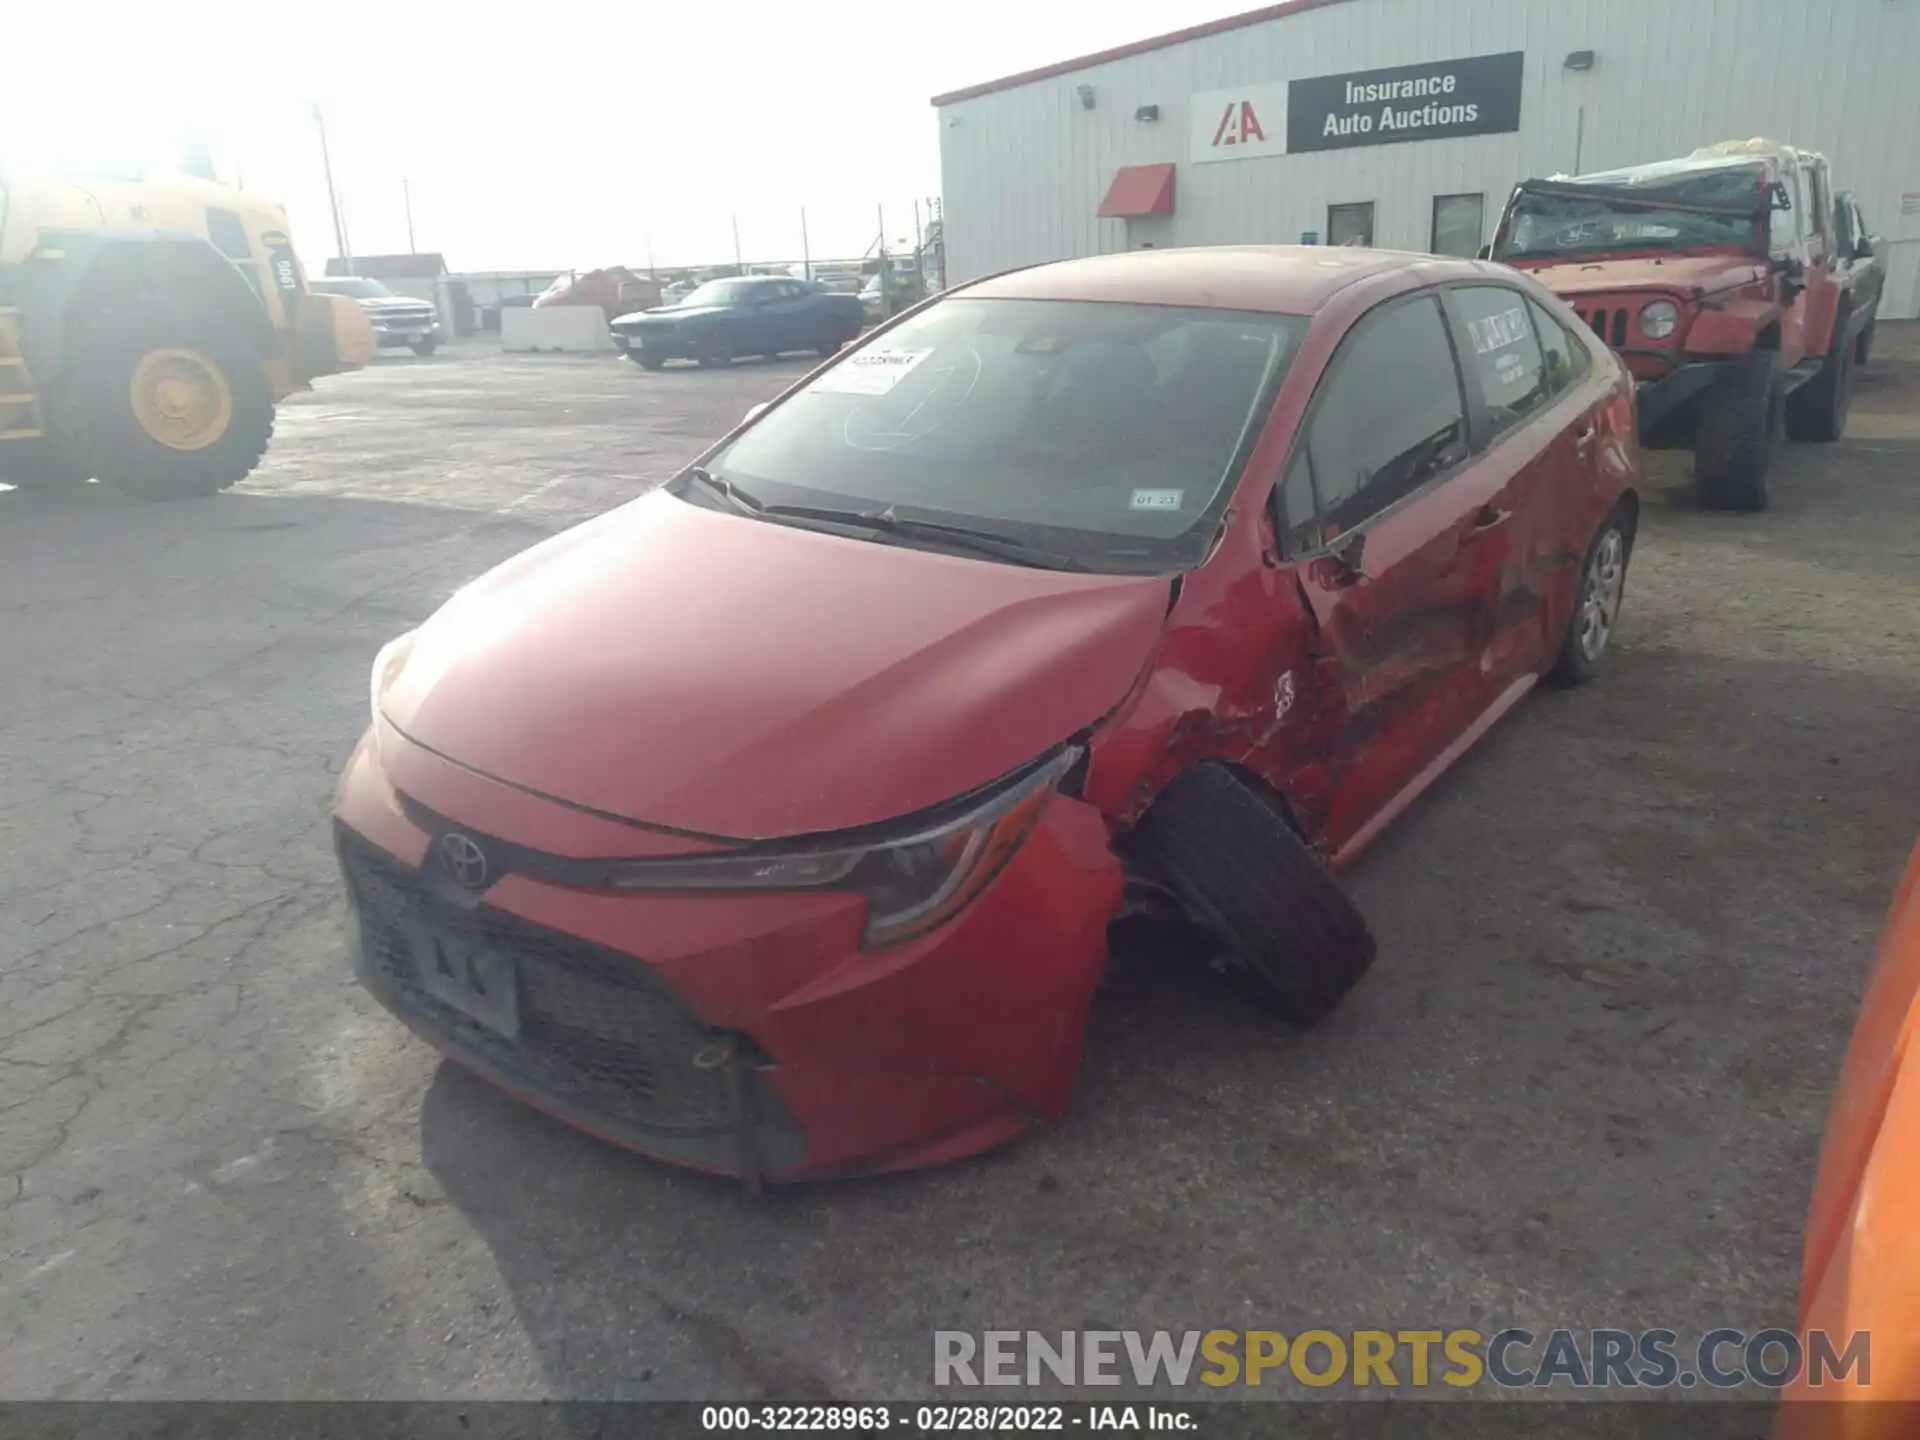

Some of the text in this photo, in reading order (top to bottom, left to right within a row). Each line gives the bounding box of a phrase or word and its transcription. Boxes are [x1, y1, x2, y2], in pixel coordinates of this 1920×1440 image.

[1344, 74, 1456, 104] Insurance
[1322, 101, 1479, 137] Auto Auctions
